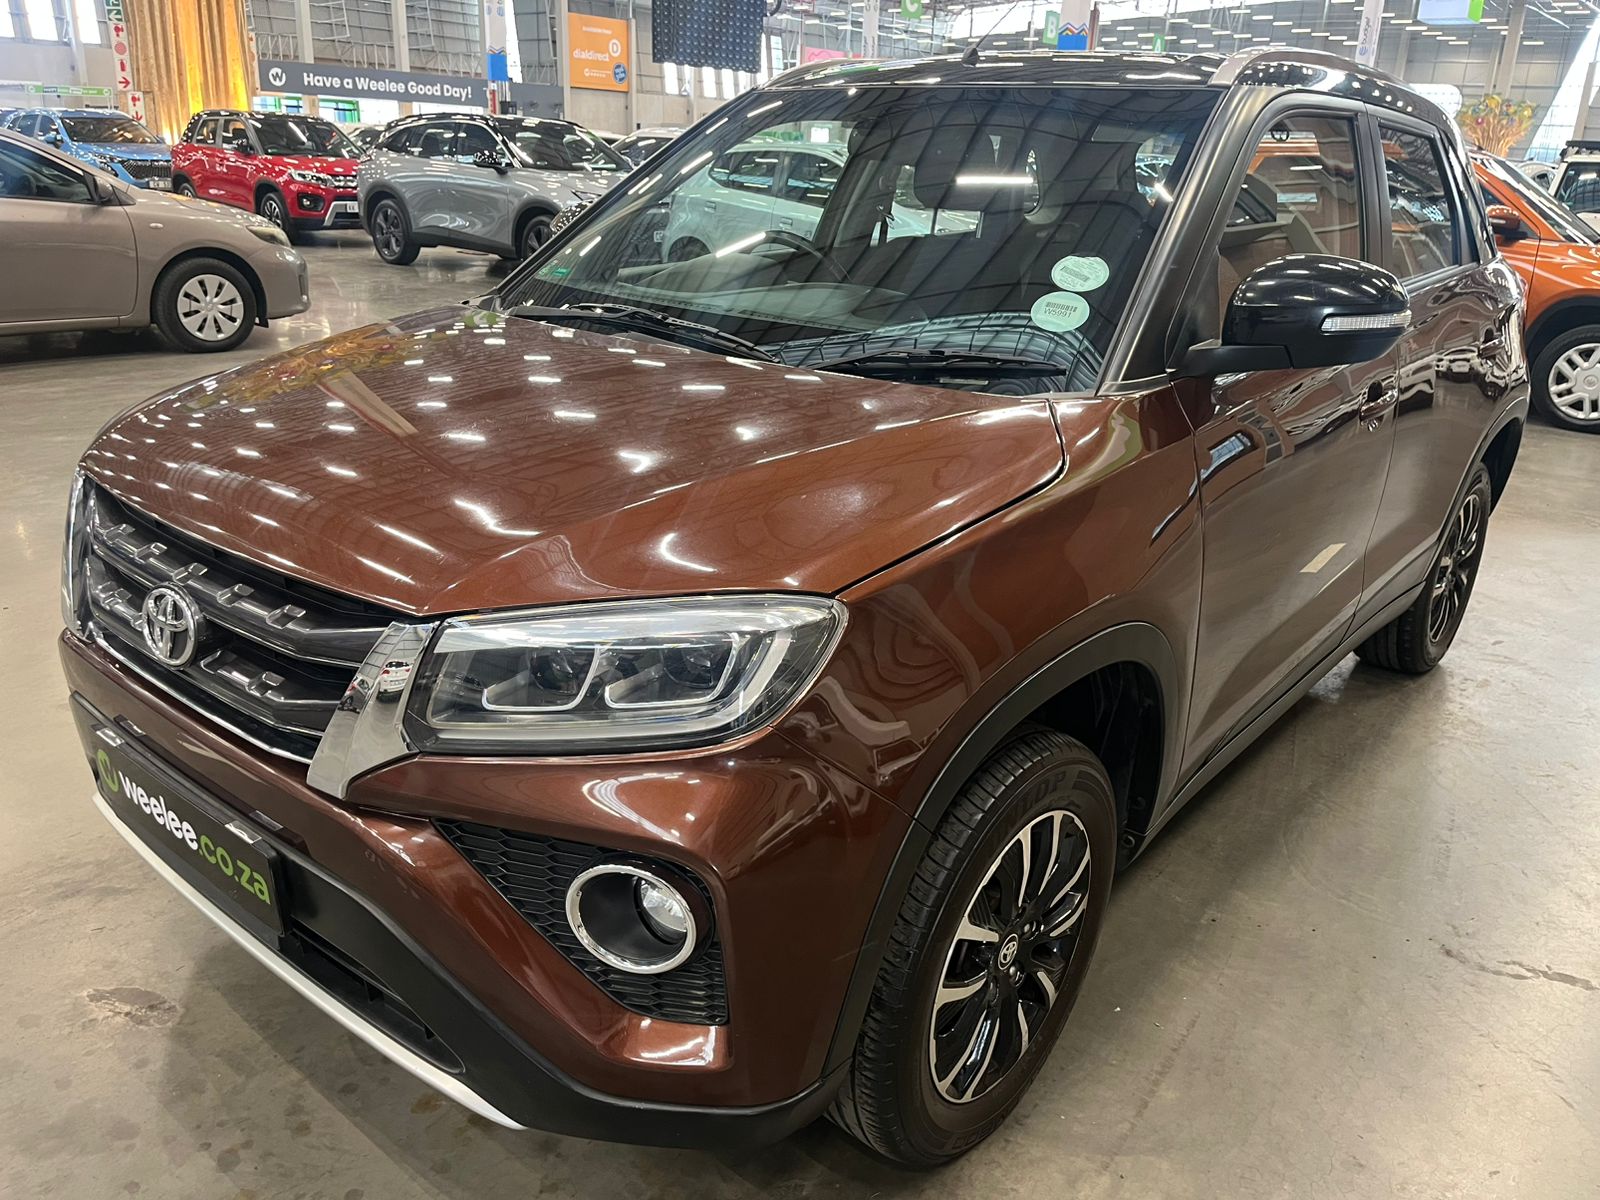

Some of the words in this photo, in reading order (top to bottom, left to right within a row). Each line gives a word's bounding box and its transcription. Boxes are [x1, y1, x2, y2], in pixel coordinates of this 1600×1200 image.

[1046, 16, 1057, 39] B
[303, 72, 341, 88] Have
[343, 78, 353, 89] a
[355, 76, 406, 93] Weelee
[407, 81, 441, 97] Good
[443, 84, 472, 101] Day!
[1044, 308, 1072, 318] W5991
[118, 771, 270, 905] weelee.co.za
